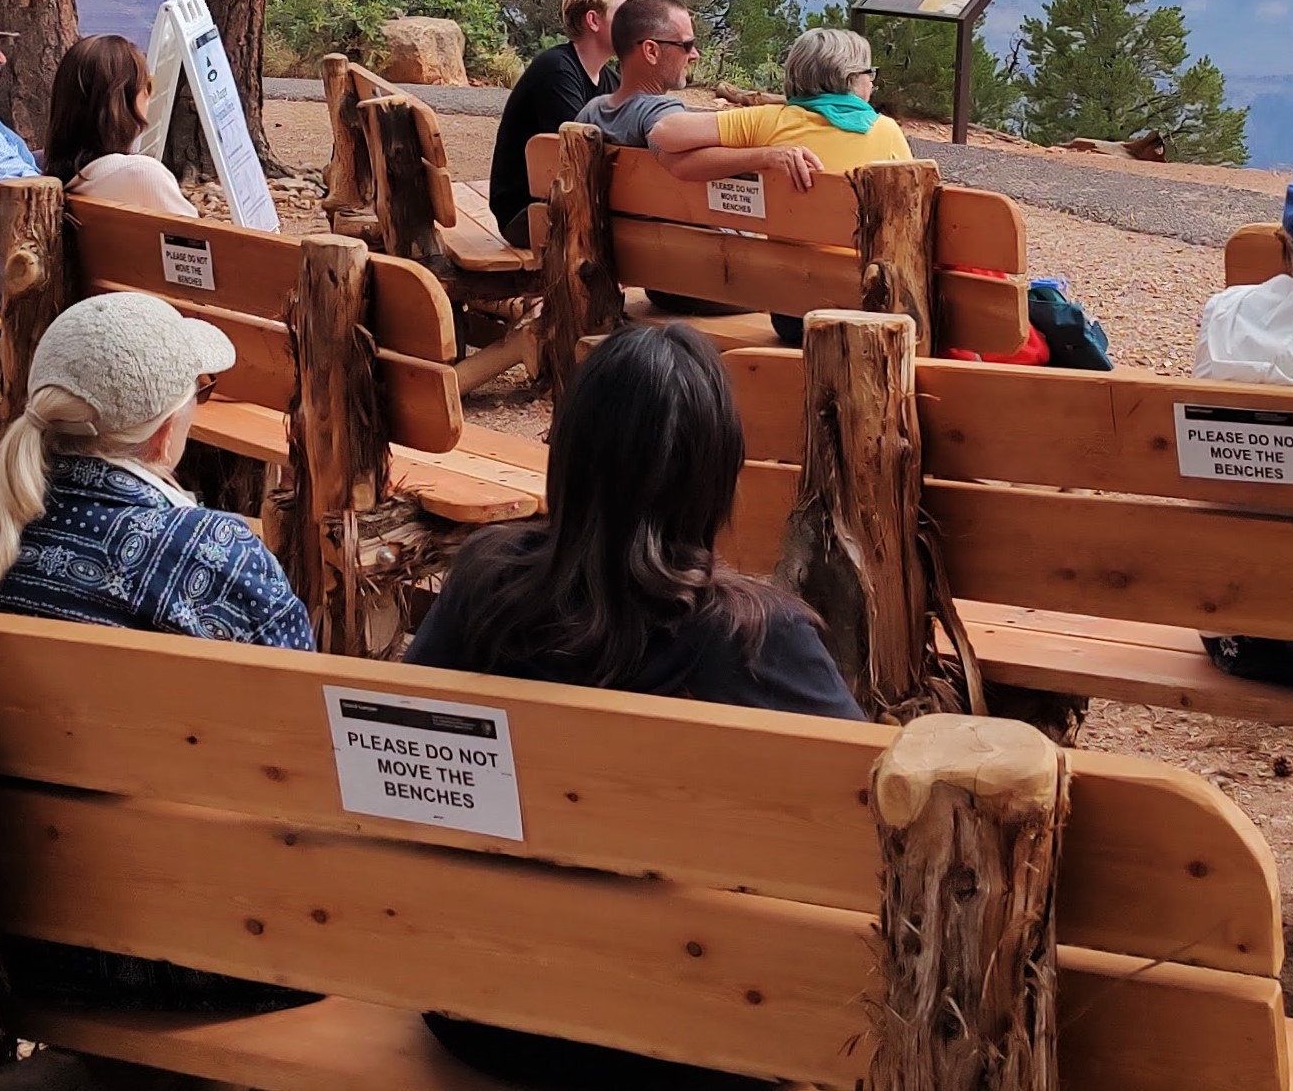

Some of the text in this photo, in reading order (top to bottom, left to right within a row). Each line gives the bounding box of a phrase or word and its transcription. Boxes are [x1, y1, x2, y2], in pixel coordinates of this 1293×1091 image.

[712, 182, 734, 191] PLEASE
[721, 193, 751, 203] MOVE THE
[1188, 430, 1244, 444] PLEASE
[1249, 434, 1269, 446] DO
[1211, 447, 1285, 463] MOVE THE
[1215, 463, 1283, 479] BENCHES
[347, 731, 499, 768] PLEASE DO NOT
[378, 759, 475, 787] MOVE THE
[385, 781, 474, 809] BENCHES
